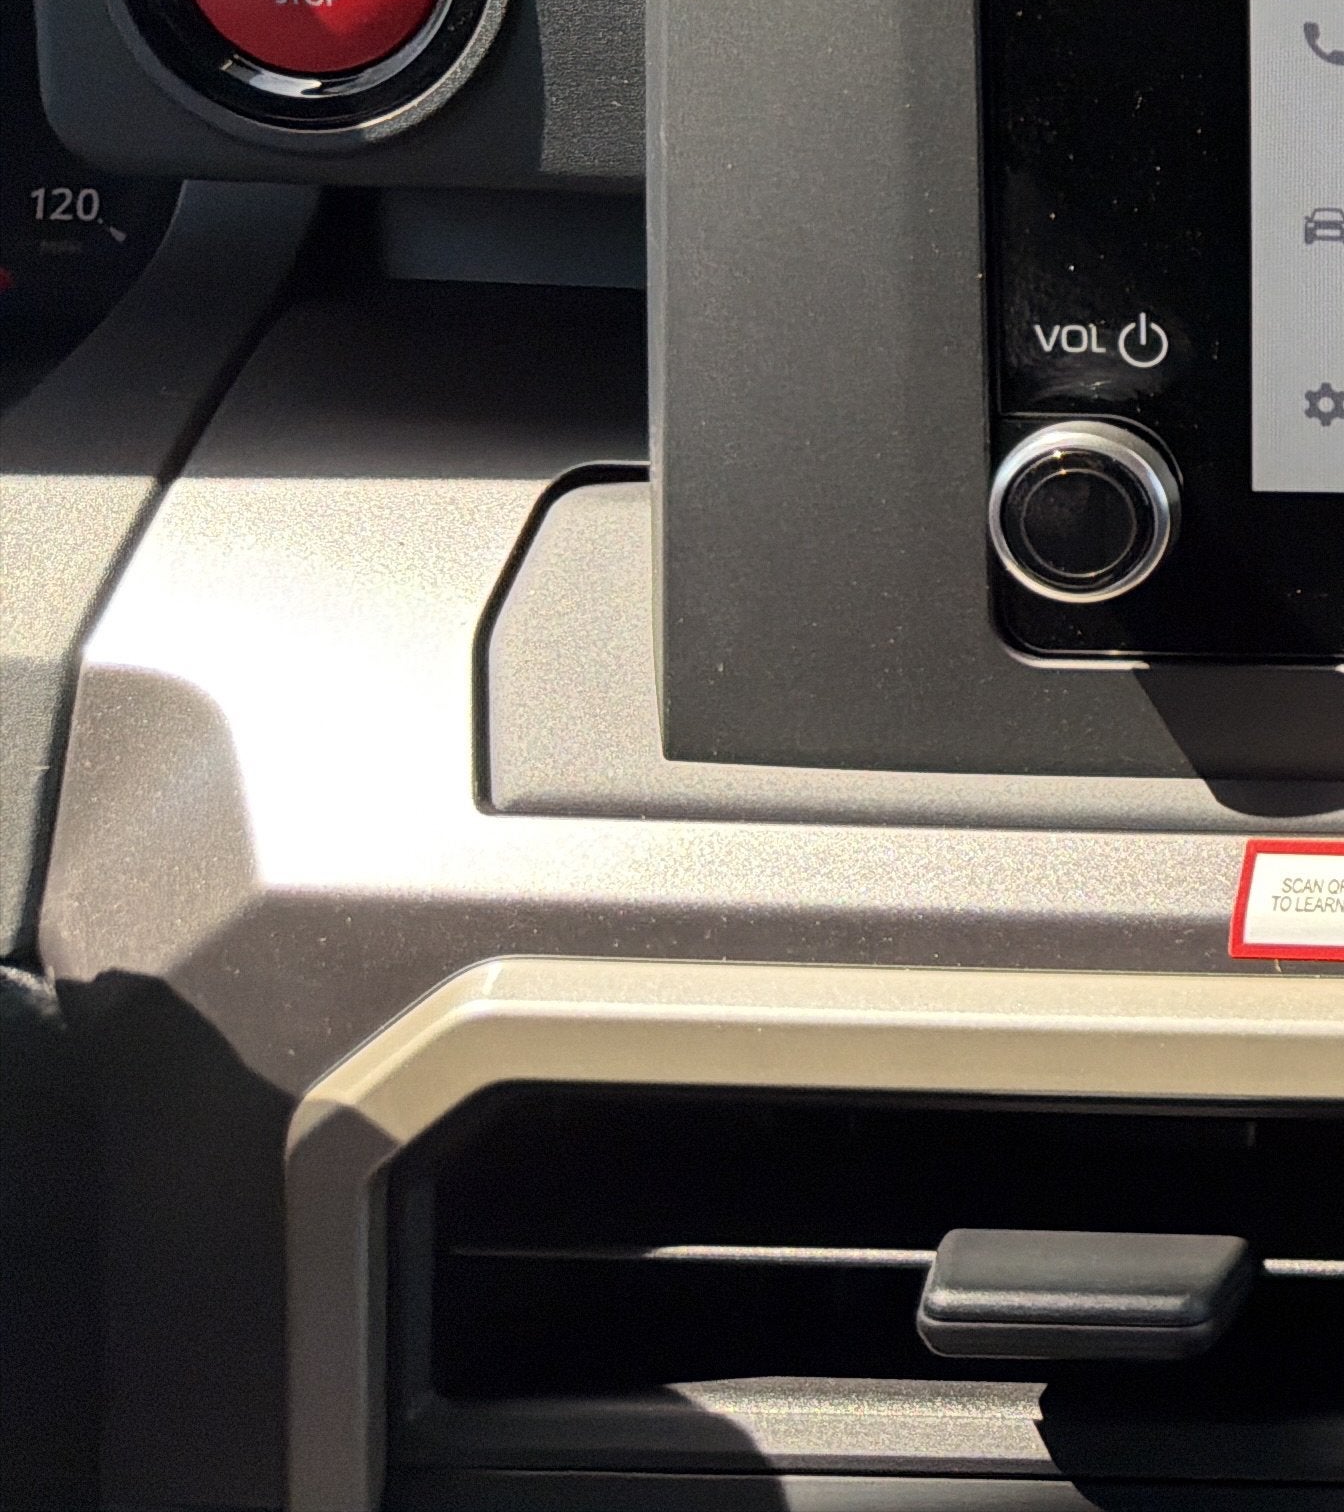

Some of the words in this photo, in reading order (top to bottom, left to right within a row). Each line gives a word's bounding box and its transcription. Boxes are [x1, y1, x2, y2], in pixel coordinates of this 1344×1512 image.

[31, 187, 100, 221] 120
[1033, 323, 1107, 353] VOL
[1282, 877, 1325, 895] SCAN
[1271, 895, 1292, 912] TO
